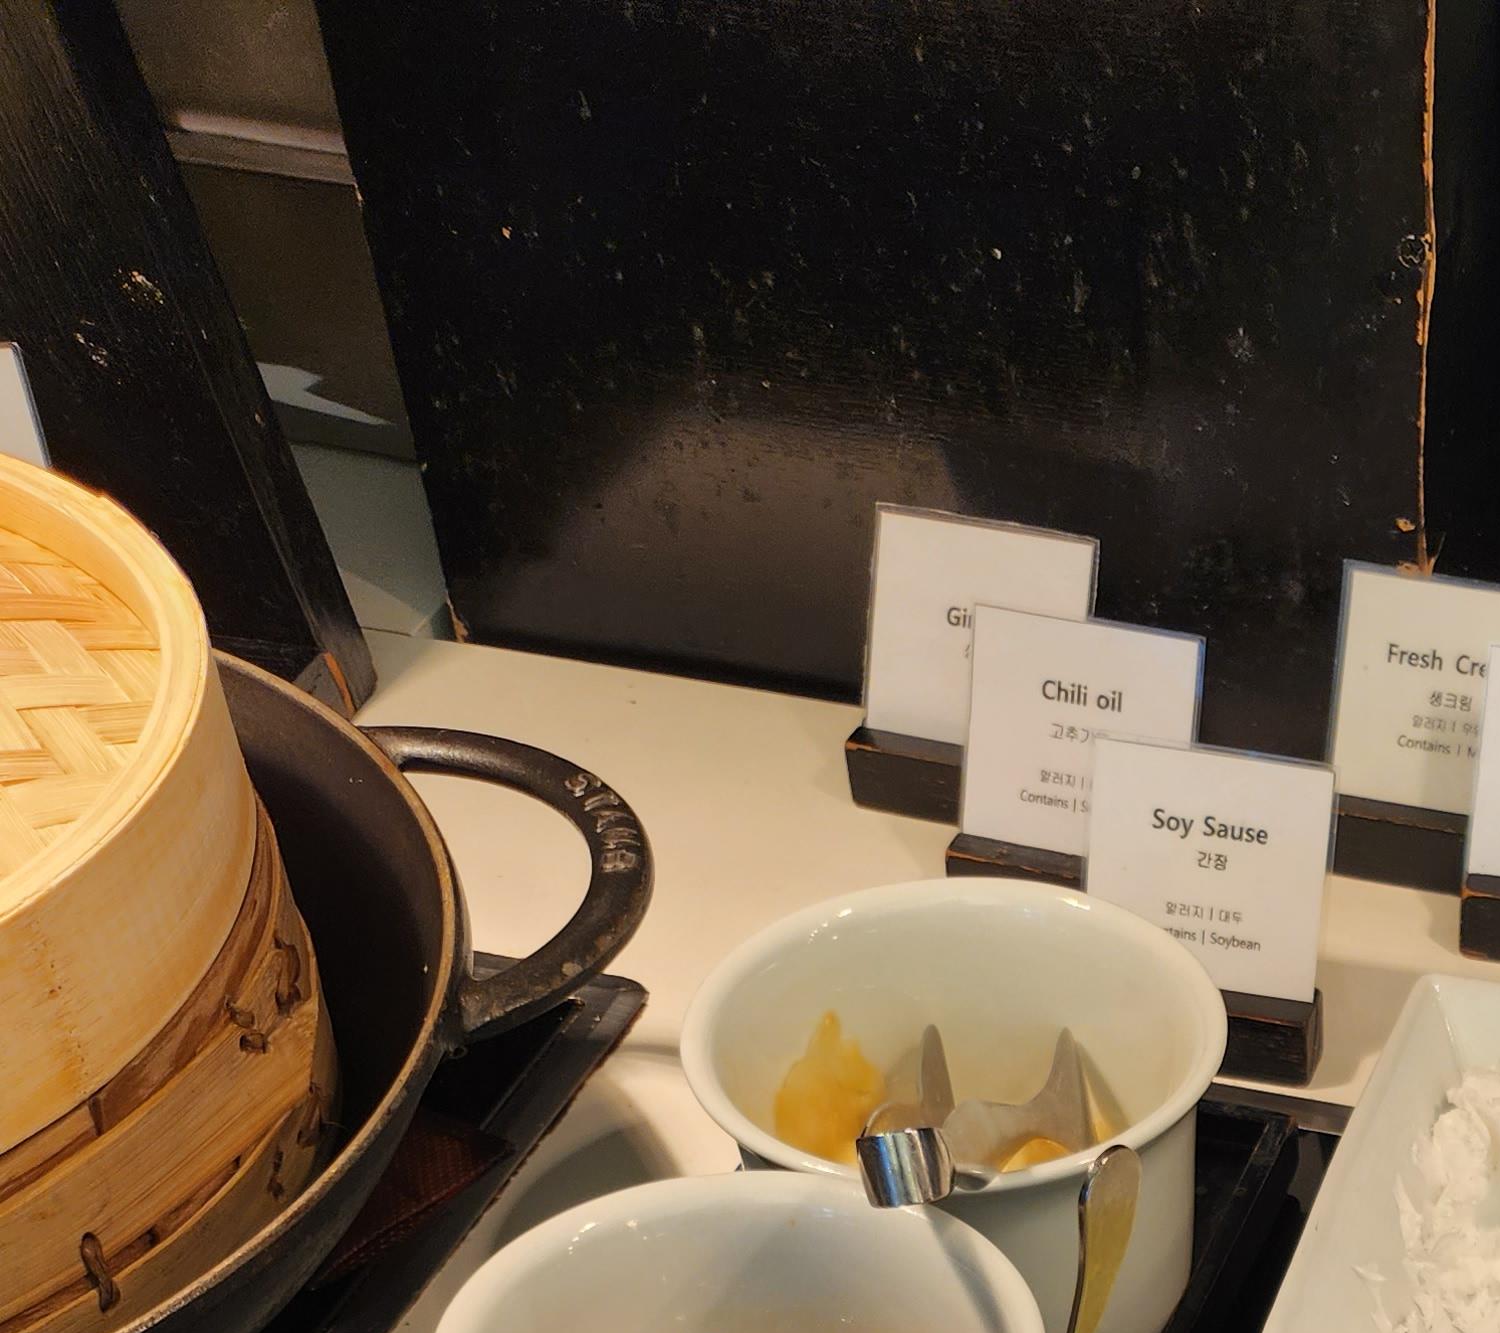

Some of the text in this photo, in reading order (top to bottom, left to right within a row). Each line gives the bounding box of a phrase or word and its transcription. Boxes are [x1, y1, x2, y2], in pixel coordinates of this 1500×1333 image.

[1387, 643, 1443, 671] Fresh
[1041, 680, 1122, 712] Chili oil
[1429, 691, 1473, 712] 생크림
[1397, 734, 1451, 754] Contains
[1019, 789, 1069, 810] Contains
[1152, 808, 1268, 845] Soy Sause
[1197, 850, 1228, 871] 간장
[1210, 932, 1261, 951] Soybean
